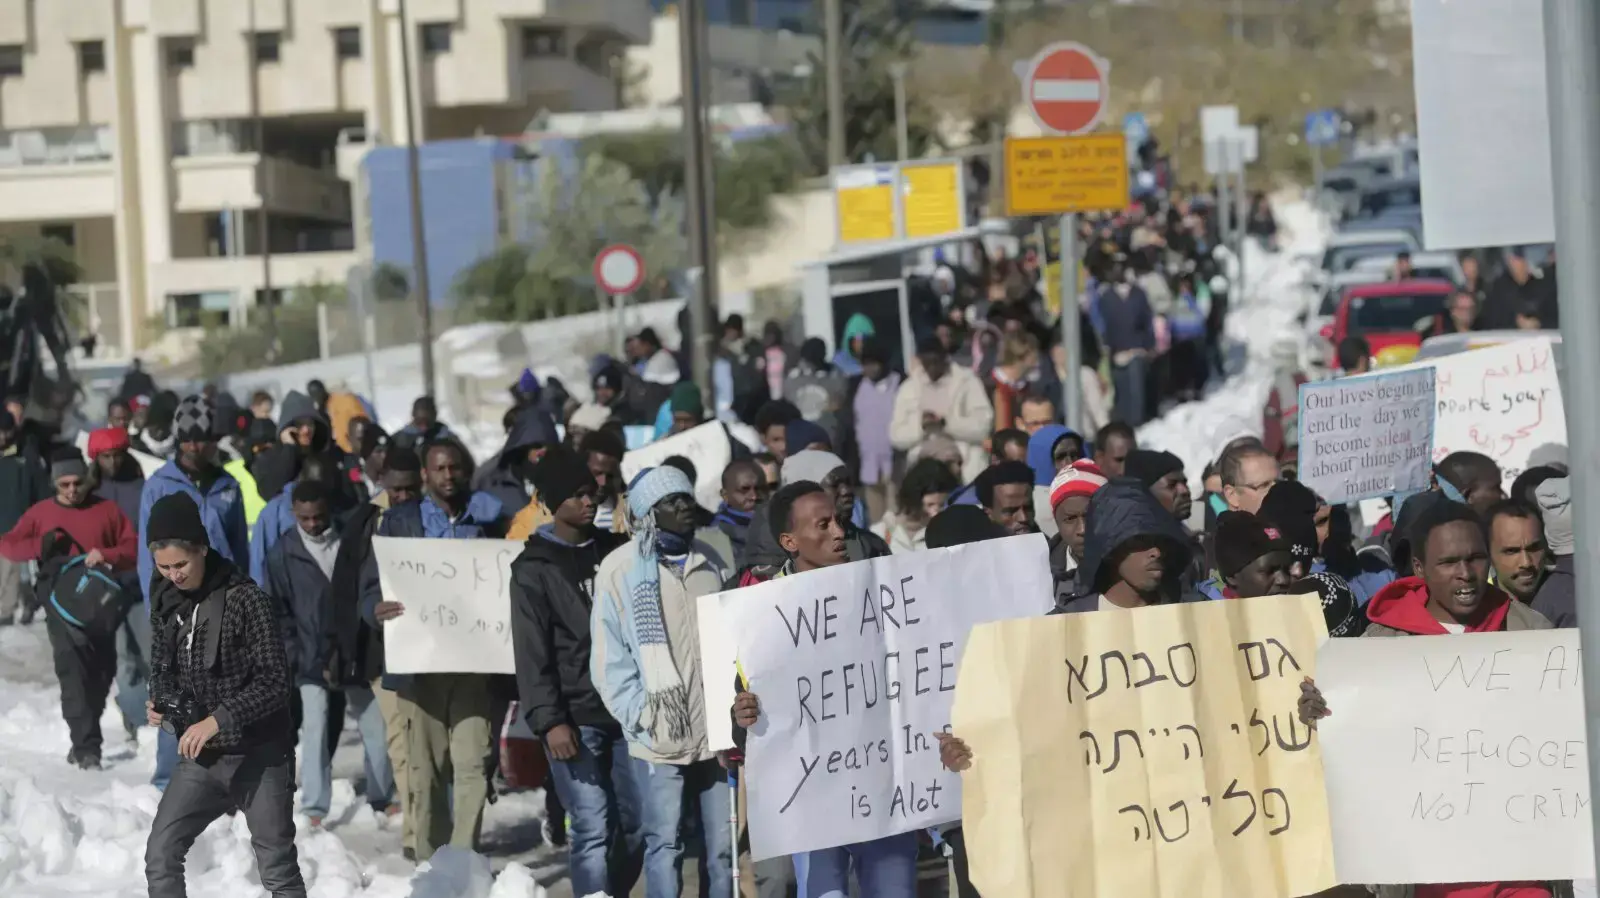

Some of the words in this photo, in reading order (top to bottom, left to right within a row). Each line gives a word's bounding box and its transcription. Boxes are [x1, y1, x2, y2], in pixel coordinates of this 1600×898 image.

[1306, 393, 1335, 410] Our
[1340, 388, 1374, 405] lives
[1377, 382, 1414, 401] begin
[1501, 388, 1552, 414] your
[1308, 415, 1336, 434] end
[1340, 412, 1361, 430] the
[1374, 406, 1398, 426] day
[1402, 406, 1420, 420] we
[1312, 458, 1353, 478] about
[1361, 451, 1401, 468] things
[1405, 442, 1428, 461] that
[1315, 435, 1371, 456] become
[1376, 428, 1411, 448] silent
[775, 595, 838, 648] WE
[860, 576, 920, 636] ARE
[1064, 642, 1197, 704] סבתא
[1238, 638, 1301, 681] גם
[1423, 649, 1512, 692] WE
[1079, 724, 1204, 774] הייתה
[1231, 708, 1314, 756] שלי
[779, 738, 889, 814] years
[902, 724, 930, 755] In
[850, 785, 871, 819] is
[890, 778, 942, 818] Alot
[1118, 778, 1291, 843] פליטה
